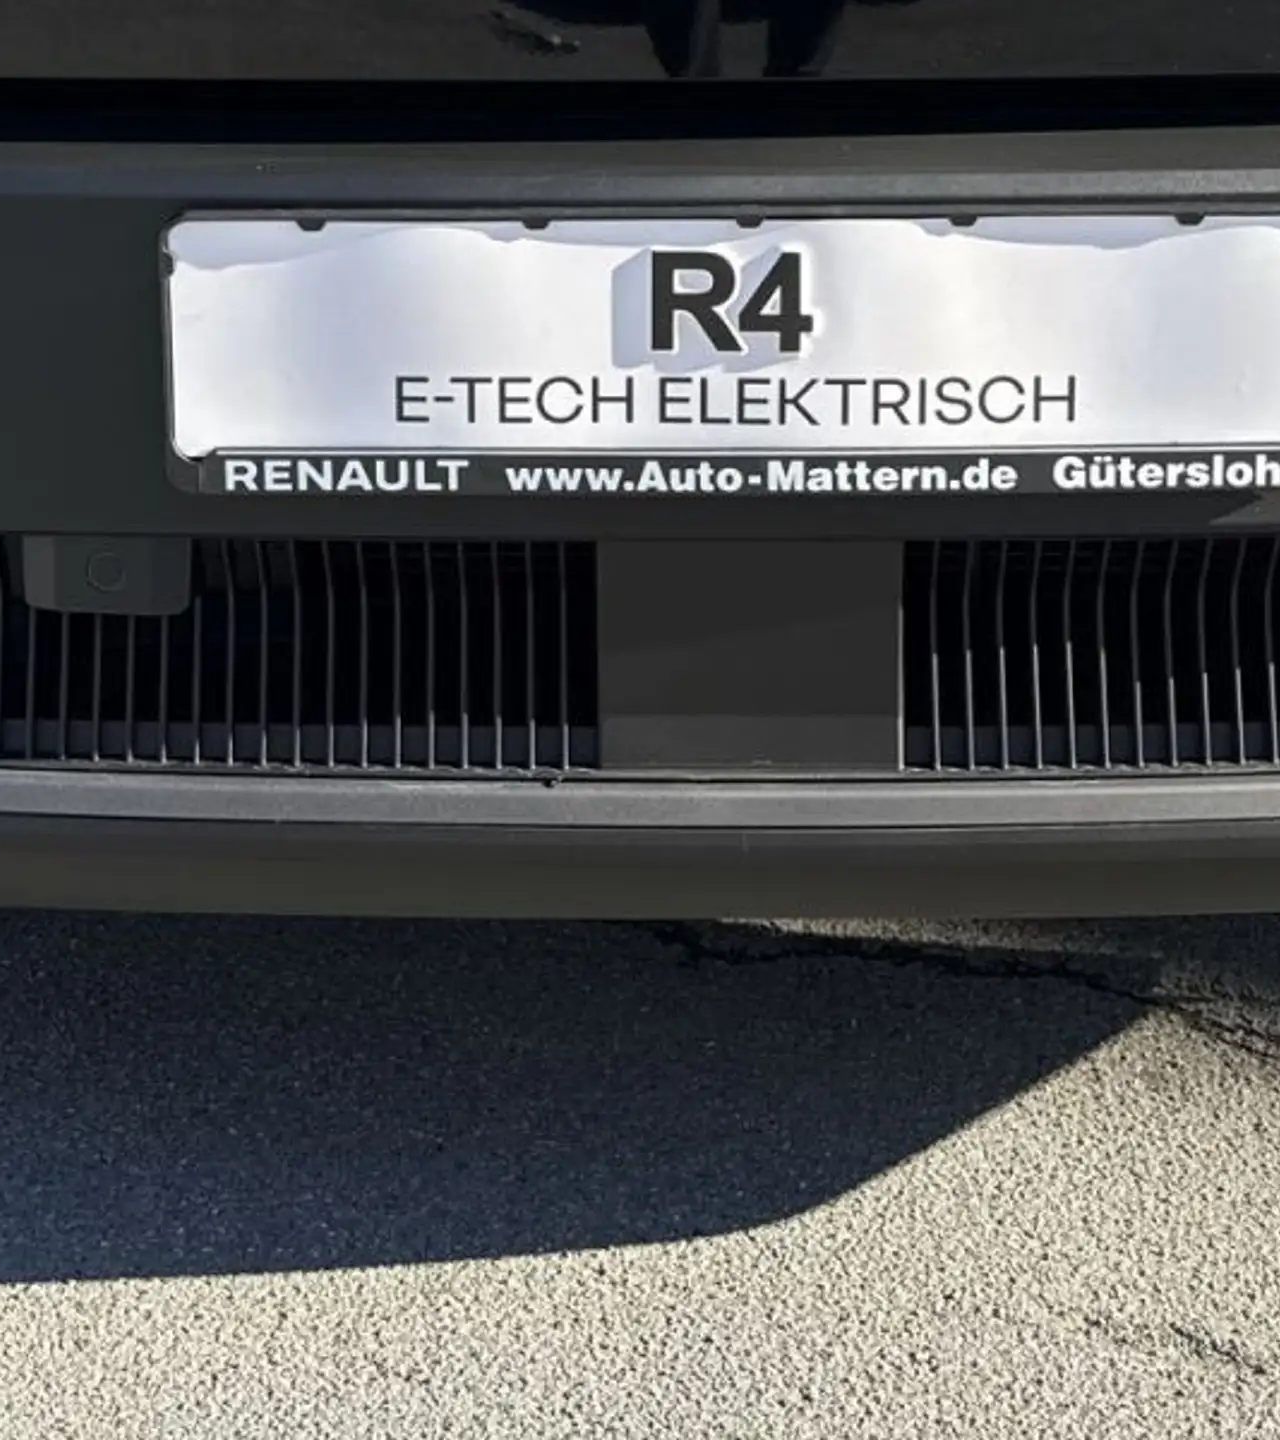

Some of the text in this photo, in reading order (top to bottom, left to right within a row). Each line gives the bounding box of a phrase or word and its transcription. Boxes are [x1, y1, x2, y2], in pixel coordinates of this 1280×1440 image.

[650, 250, 813, 354] R4
[394, 374, 1078, 426] E-TECH ELEKTRISCH
[223, 459, 470, 492] RENAULT
[505, 457, 1019, 494] www.Auto-Mattern.de
